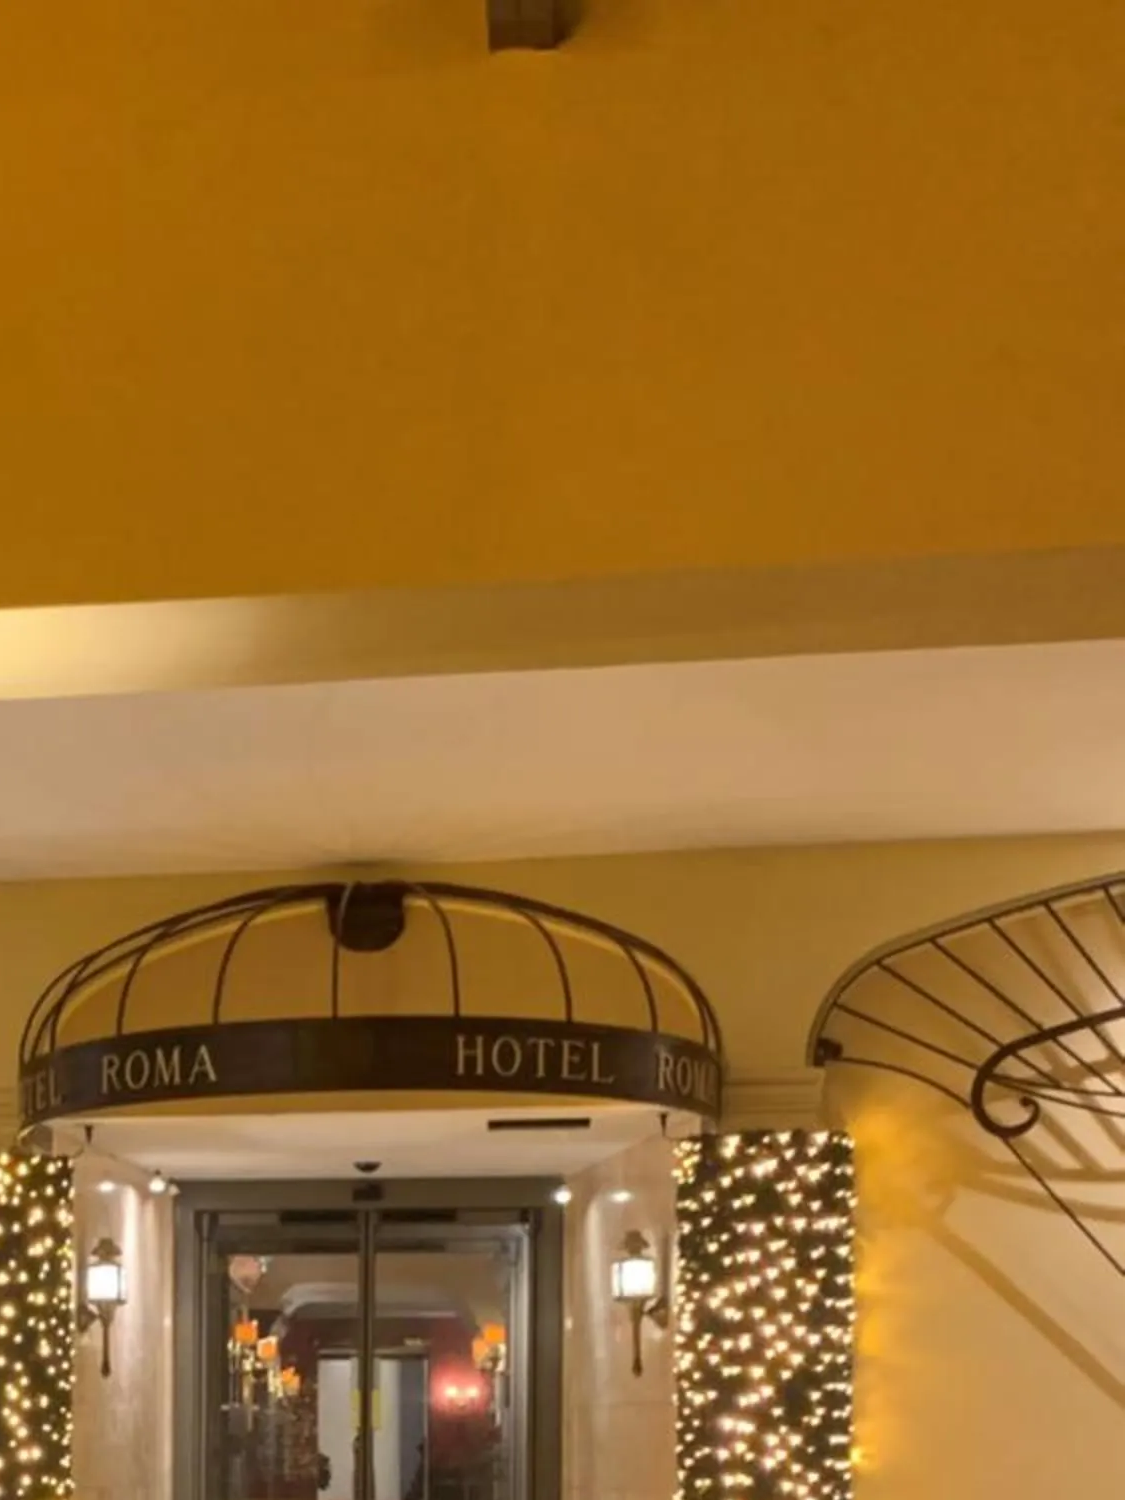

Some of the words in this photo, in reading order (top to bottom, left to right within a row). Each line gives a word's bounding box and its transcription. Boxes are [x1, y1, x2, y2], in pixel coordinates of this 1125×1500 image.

[21, 1066, 62, 1116] TEL
[101, 1044, 217, 1094] ROMA
[455, 1034, 616, 1084] HOTEL
